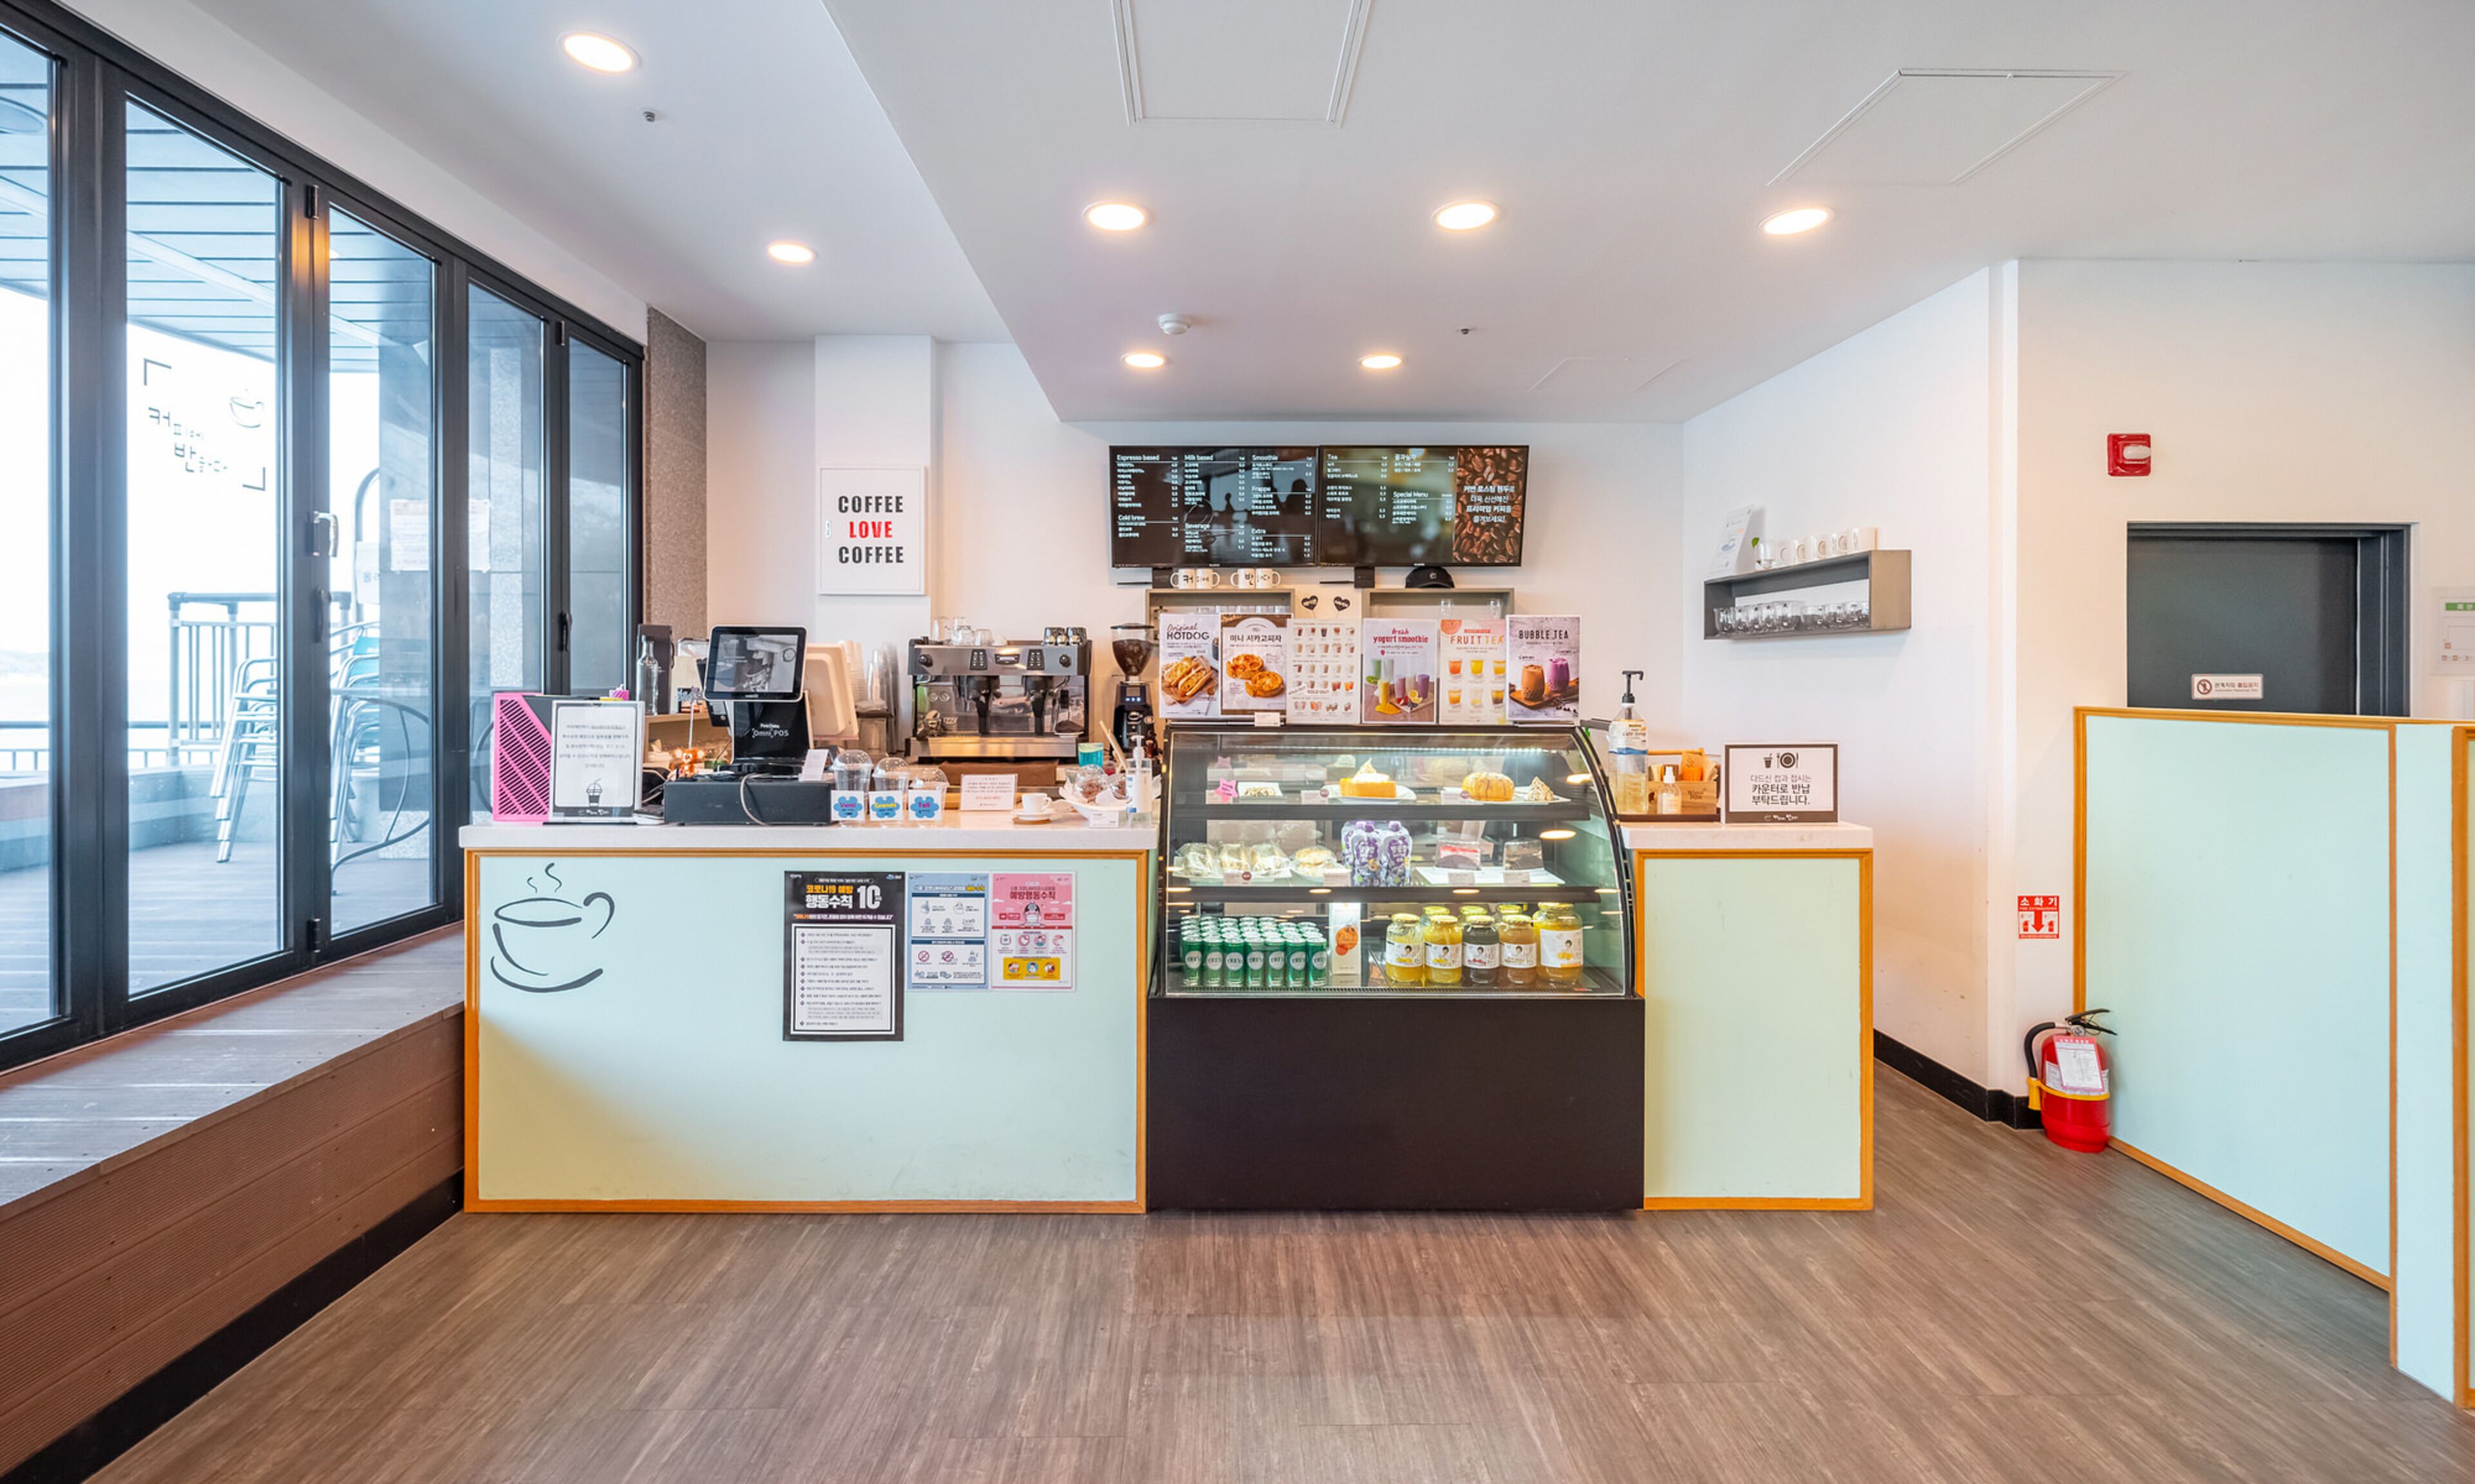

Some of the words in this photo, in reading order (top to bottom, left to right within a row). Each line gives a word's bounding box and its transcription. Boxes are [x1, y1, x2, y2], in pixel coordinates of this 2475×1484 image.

[839, 496, 904, 514] COFFEE
[1466, 505, 1491, 513] 프리미엄
[1493, 505, 1511, 513] 커피를
[849, 521, 893, 538] LOVE
[839, 546, 904, 564] COFFEE
[1167, 622, 1198, 632] Original
[1167, 631, 1210, 641] HOTDOG
[1246, 634, 1281, 642] 시카고피자
[1450, 635, 1482, 644] FRUIT
[1484, 635, 1504, 644] TEA
[1519, 630, 1549, 639] BUBBLE
[1553, 630, 1569, 639] TEA
[1774, 775, 1789, 783] 컵과
[1791, 775, 1812, 783] 접시는
[1752, 784, 1789, 795] 카운터로
[1792, 784, 1810, 795] 반납
[1752, 795, 1810, 805] 부탁드립니다.
[806, 885, 837, 894] 코로나19
[838, 885, 854, 894] 예방
[857, 885, 881, 909] 10
[1009, 891, 1056, 900] 예방행동수칙
[805, 894, 853, 909] 행동수칙
[2020, 896, 2057, 907] 소화기
